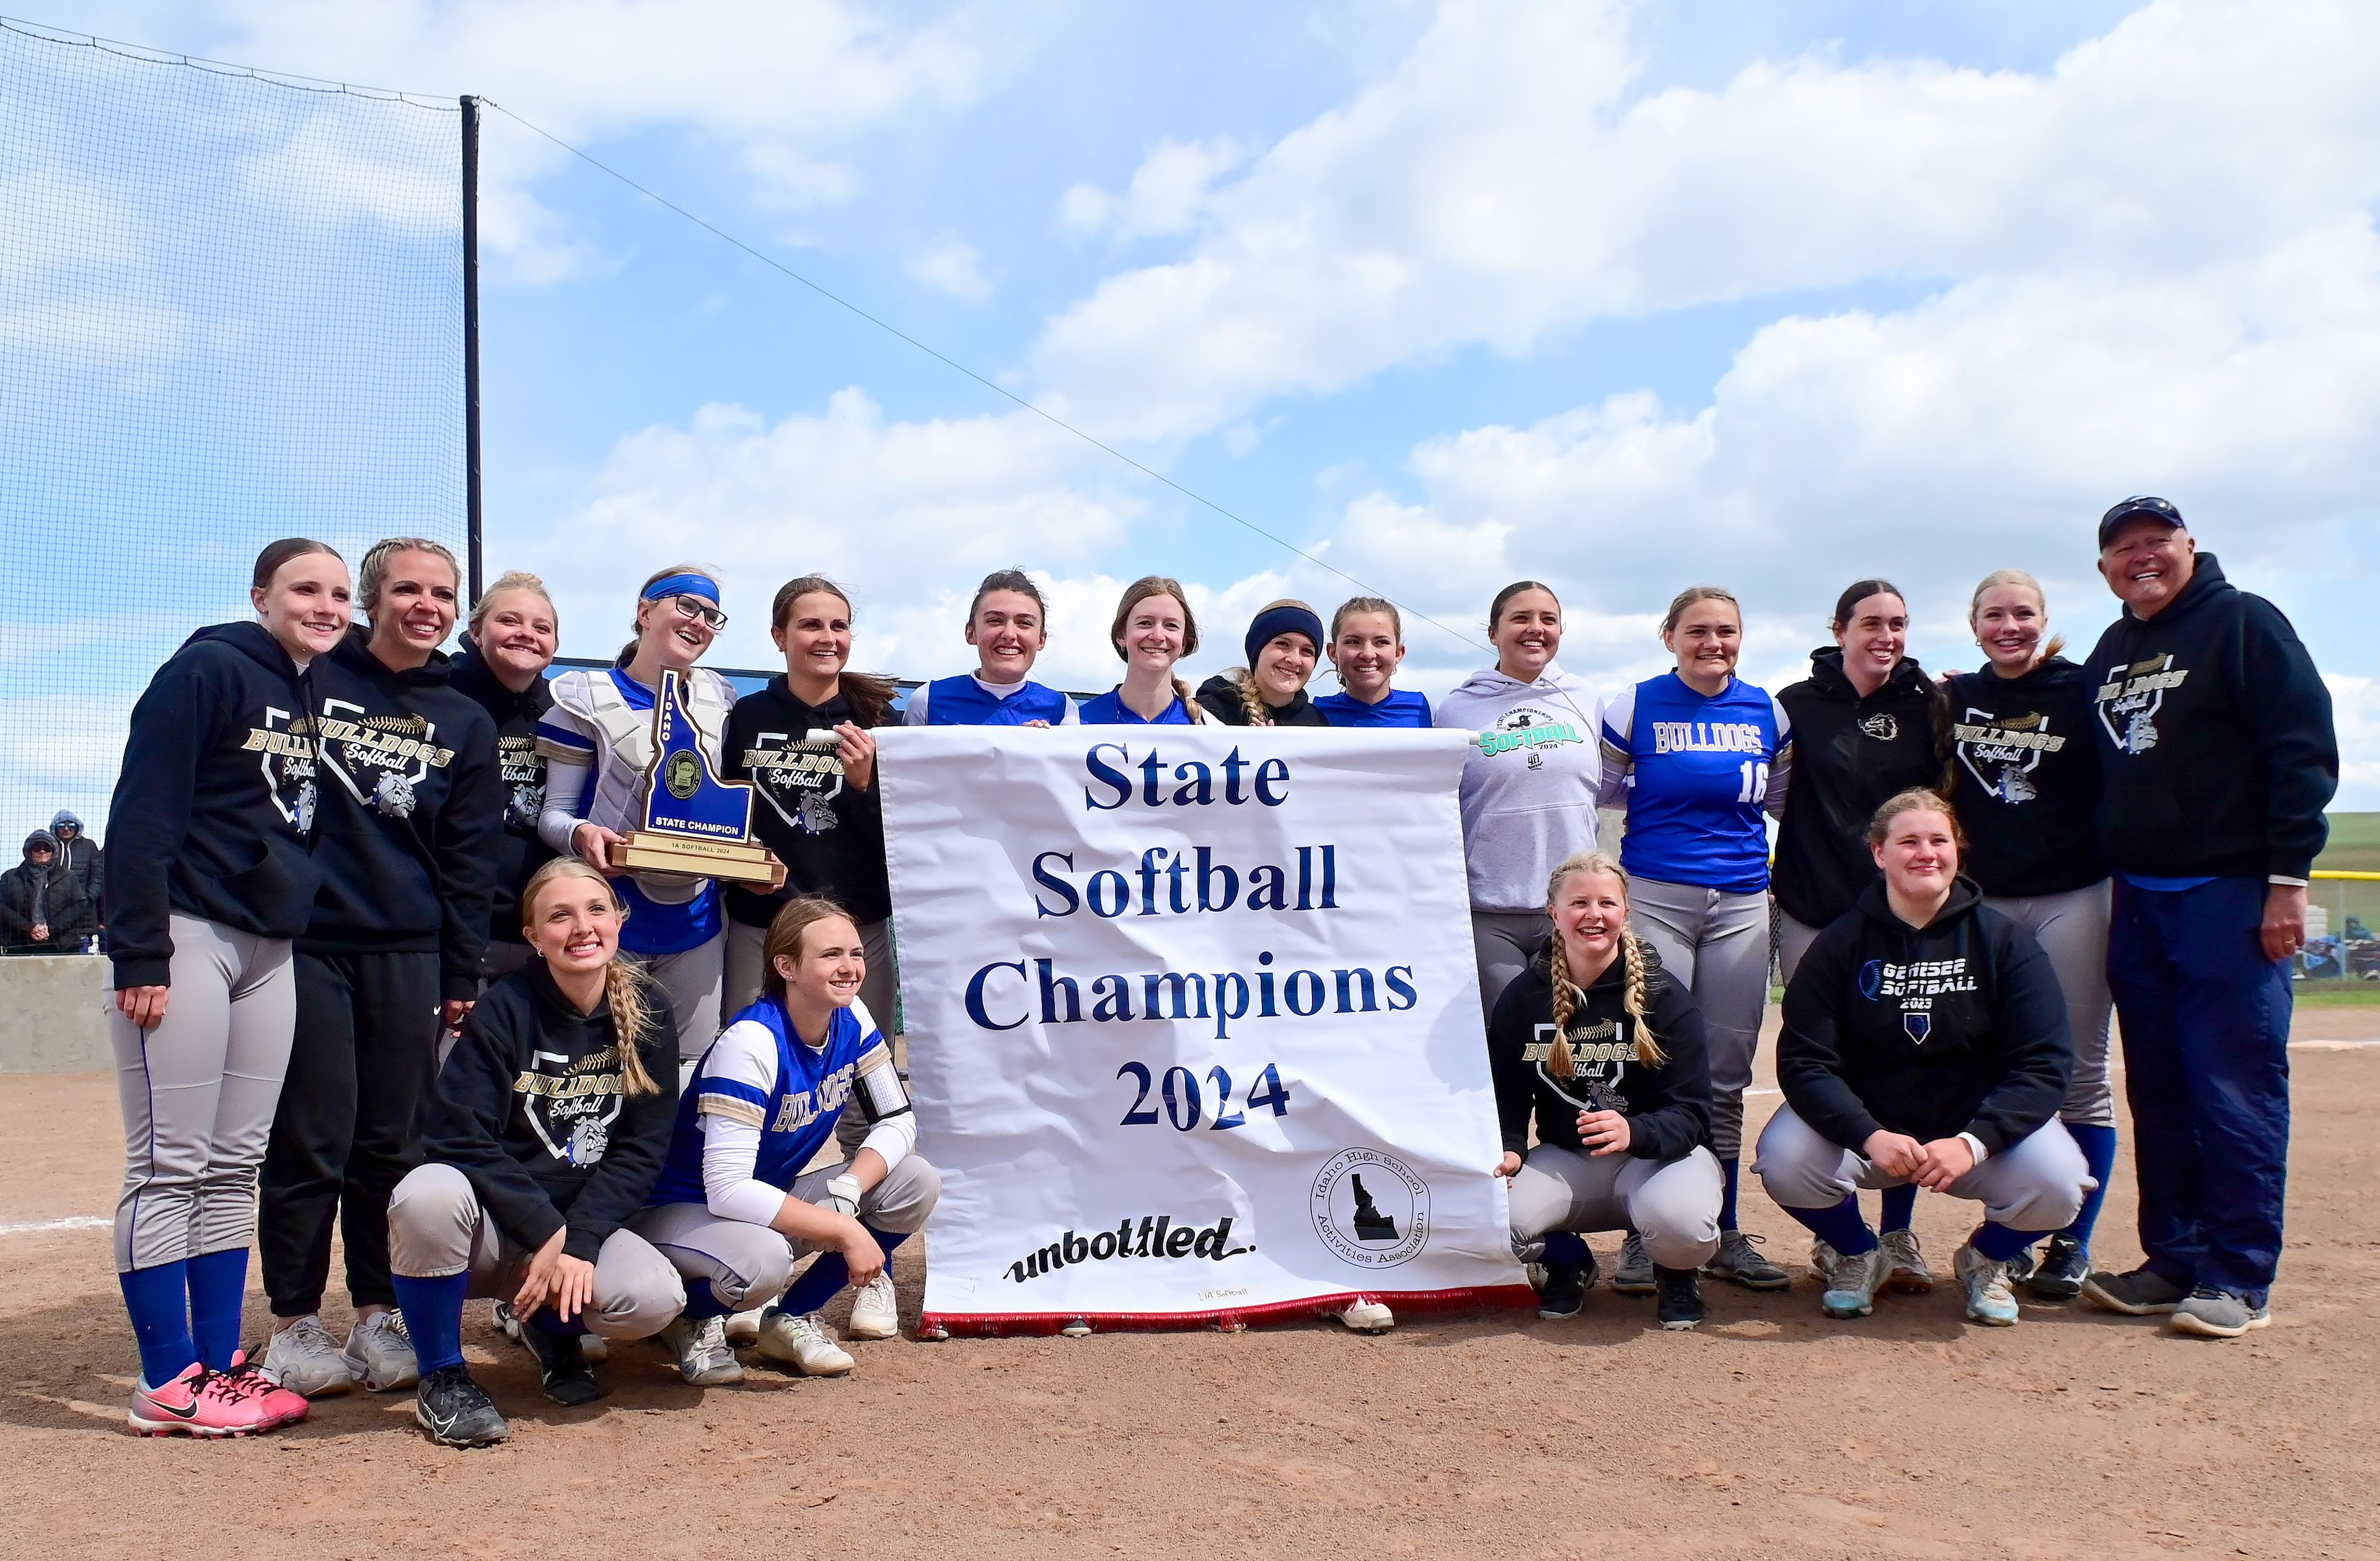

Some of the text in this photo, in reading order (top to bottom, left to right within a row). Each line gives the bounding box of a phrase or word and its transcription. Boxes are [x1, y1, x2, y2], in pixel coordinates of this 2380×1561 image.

[662, 692, 673, 741] IDAHO
[1504, 708, 1554, 722] CHAMPIONSHIPS
[1478, 721, 1584, 757] SOFTBALL
[1653, 722, 1763, 755] BULLDOGS
[348, 745, 407, 771] Softball
[1974, 744, 2024, 763] Softball
[770, 769, 825, 789] Softball
[1085, 743, 1290, 811] State
[1737, 760, 1769, 804] 16
[656, 816, 739, 835] STATE CHAMPION
[682, 844, 714, 852] SOFTBALL
[1032, 844, 1341, 919] Softball
[964, 951, 1417, 1040] Champions
[1880, 976, 1978, 996] SOFTBALL
[1900, 997, 1933, 1009] 2023
[549, 1095, 605, 1120] Softball
[1116, 1061, 1290, 1132] 2024
[1315, 1151, 1424, 1200] Idaho High School
[1318, 1210, 1424, 1263] Activities Association
[1216, 1288, 1248, 1298] Softball
